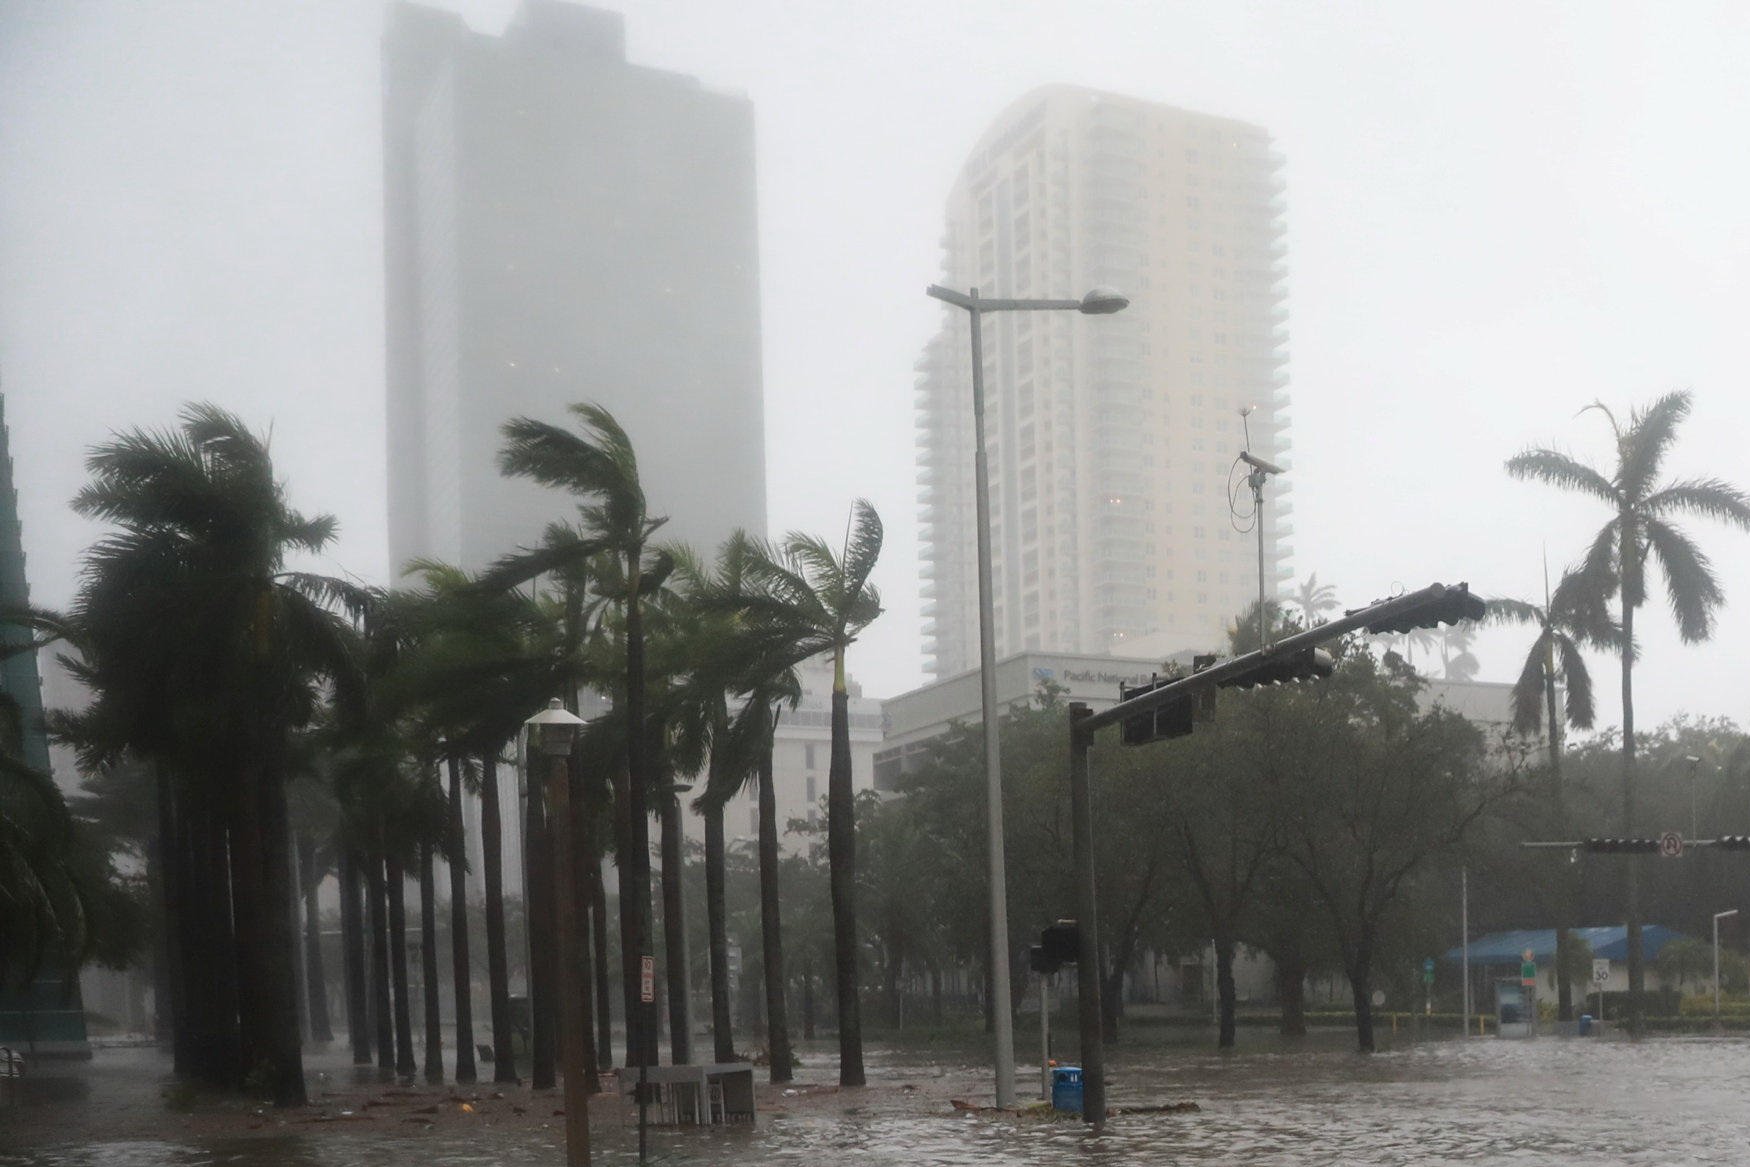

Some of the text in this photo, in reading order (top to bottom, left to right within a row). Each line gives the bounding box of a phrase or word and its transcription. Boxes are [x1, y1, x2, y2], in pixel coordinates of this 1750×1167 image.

[1064, 669, 1095, 682] Pacific
[1098, 671, 1139, 685] National
[1595, 970, 1608, 981] 30
